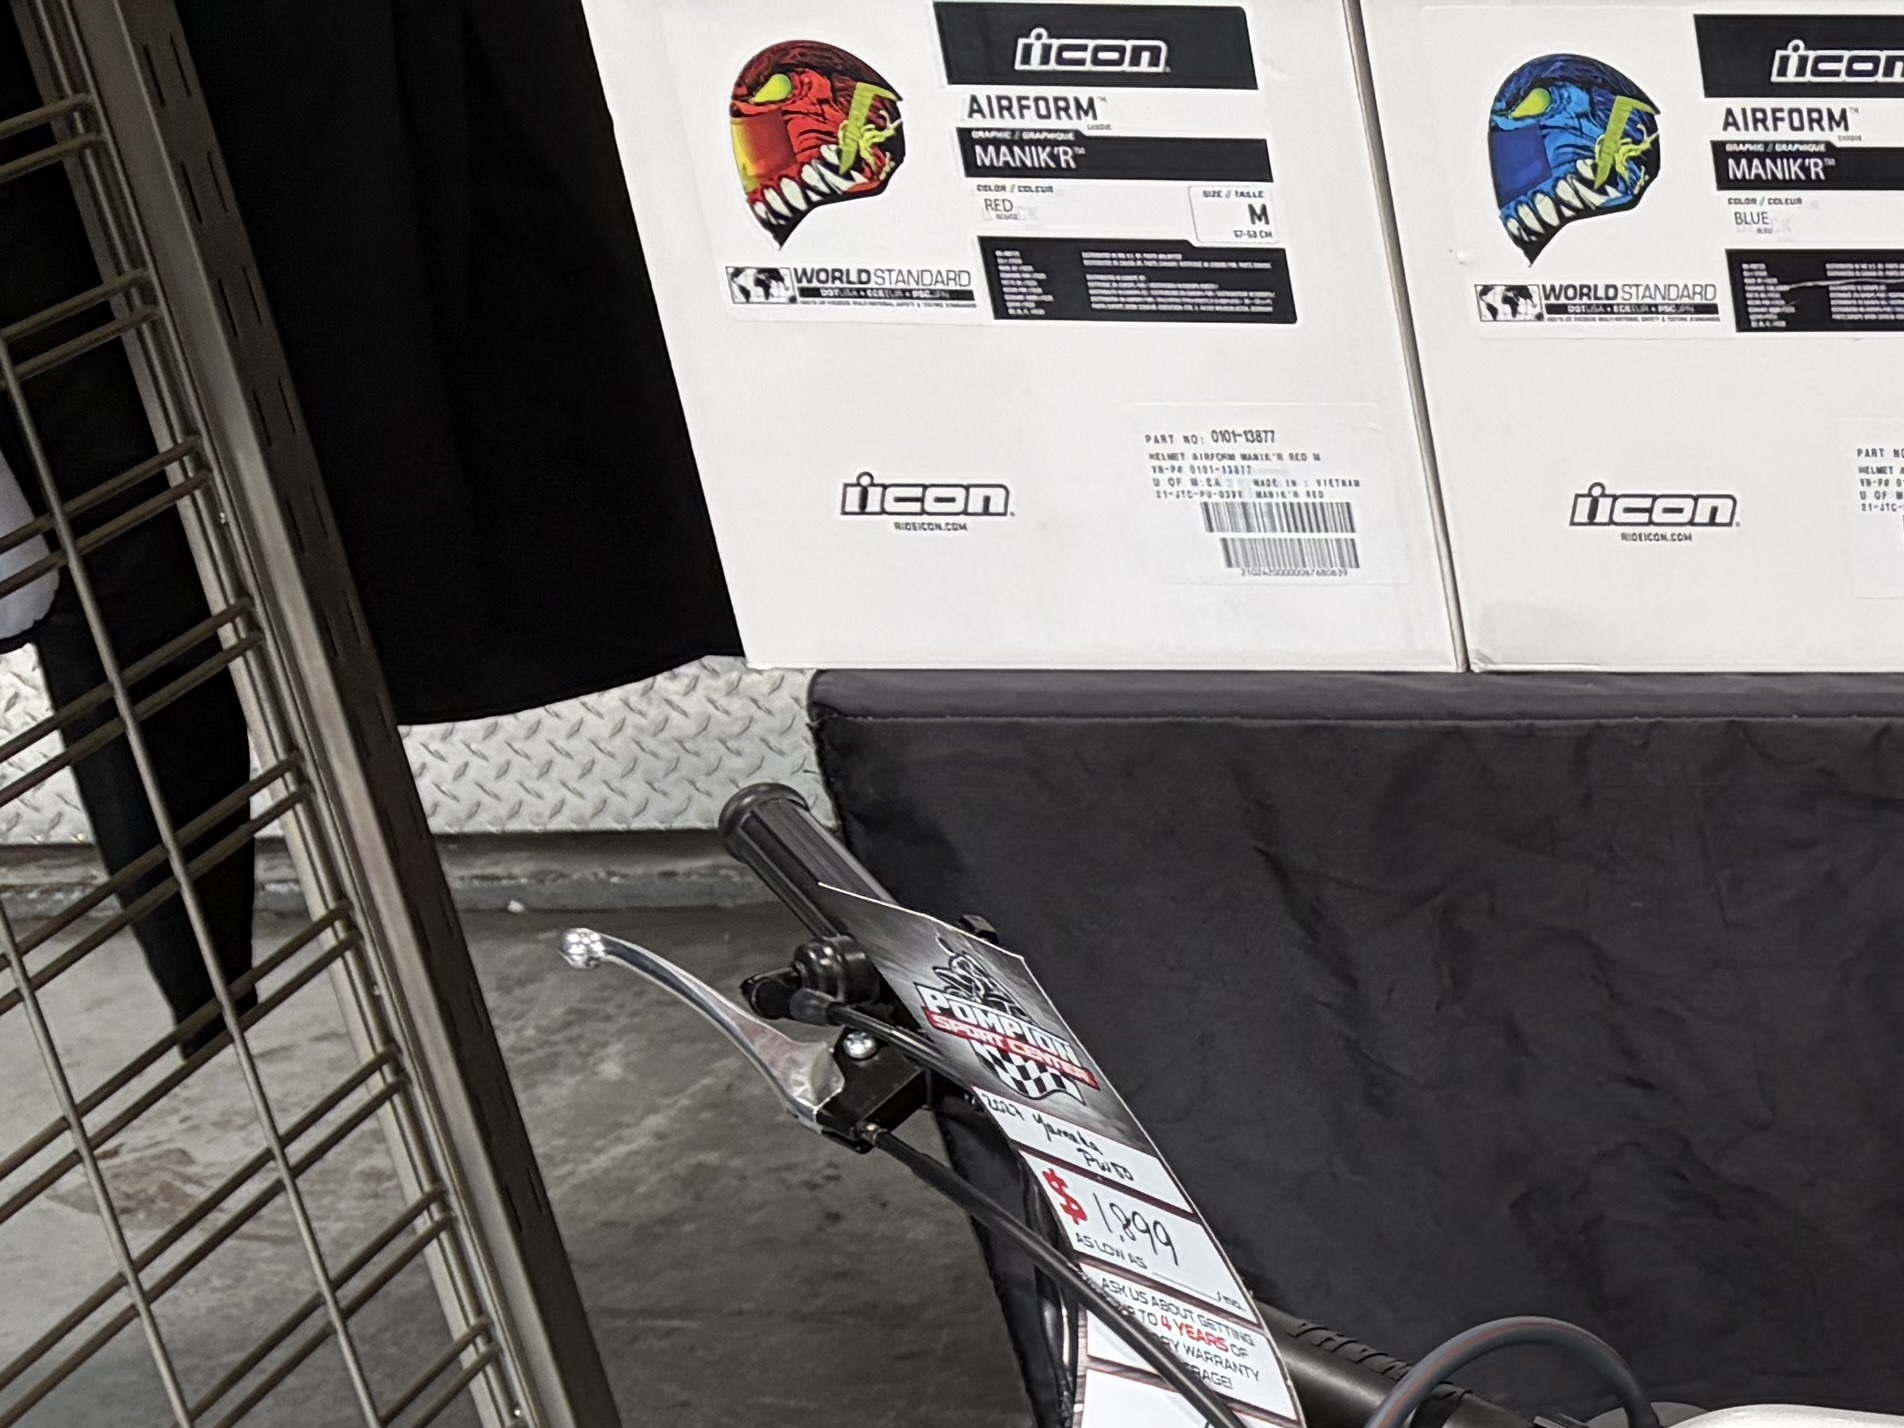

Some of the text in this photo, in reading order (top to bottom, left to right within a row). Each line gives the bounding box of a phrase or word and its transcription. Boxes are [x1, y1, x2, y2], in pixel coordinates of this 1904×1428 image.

[984, 199, 1014, 213] RED
[1249, 204, 1270, 225] M
[1734, 211, 1770, 225] BLUE
[794, 267, 972, 287] WORLD STANDARD
[1542, 284, 1717, 301] WORLD STANDARD
[1145, 434, 1174, 444] PART
[1211, 430, 1276, 444] 0101-13877
[1857, 448, 1884, 458] PART
[894, 521, 968, 532] RIDEICON.COM
[1620, 532, 1692, 542] RIDEICON.COM
[915, 982, 1082, 1067] POMPTON
[931, 1012, 1091, 1080] SPORT CENTER
[1033, 1114, 1103, 1155] Yamaha
[1076, 1232, 1093, 1248] AS
[1098, 1242, 1125, 1260] LOW
[1127, 1252, 1148, 1269] AS
[1101, 1278, 1128, 1299] ASK
[1129, 1286, 1149, 1305] US
[1151, 1295, 1194, 1320] ABOUT
[1198, 1314, 1256, 1347] GETTING
[1138, 1308, 1158, 1327] TO
[1160, 1314, 1173, 1331] 4
[1173, 1319, 1229, 1353] YEARS
[1230, 1343, 1250, 1359] OF
[1182, 1344, 1260, 1382] WARRANTY
